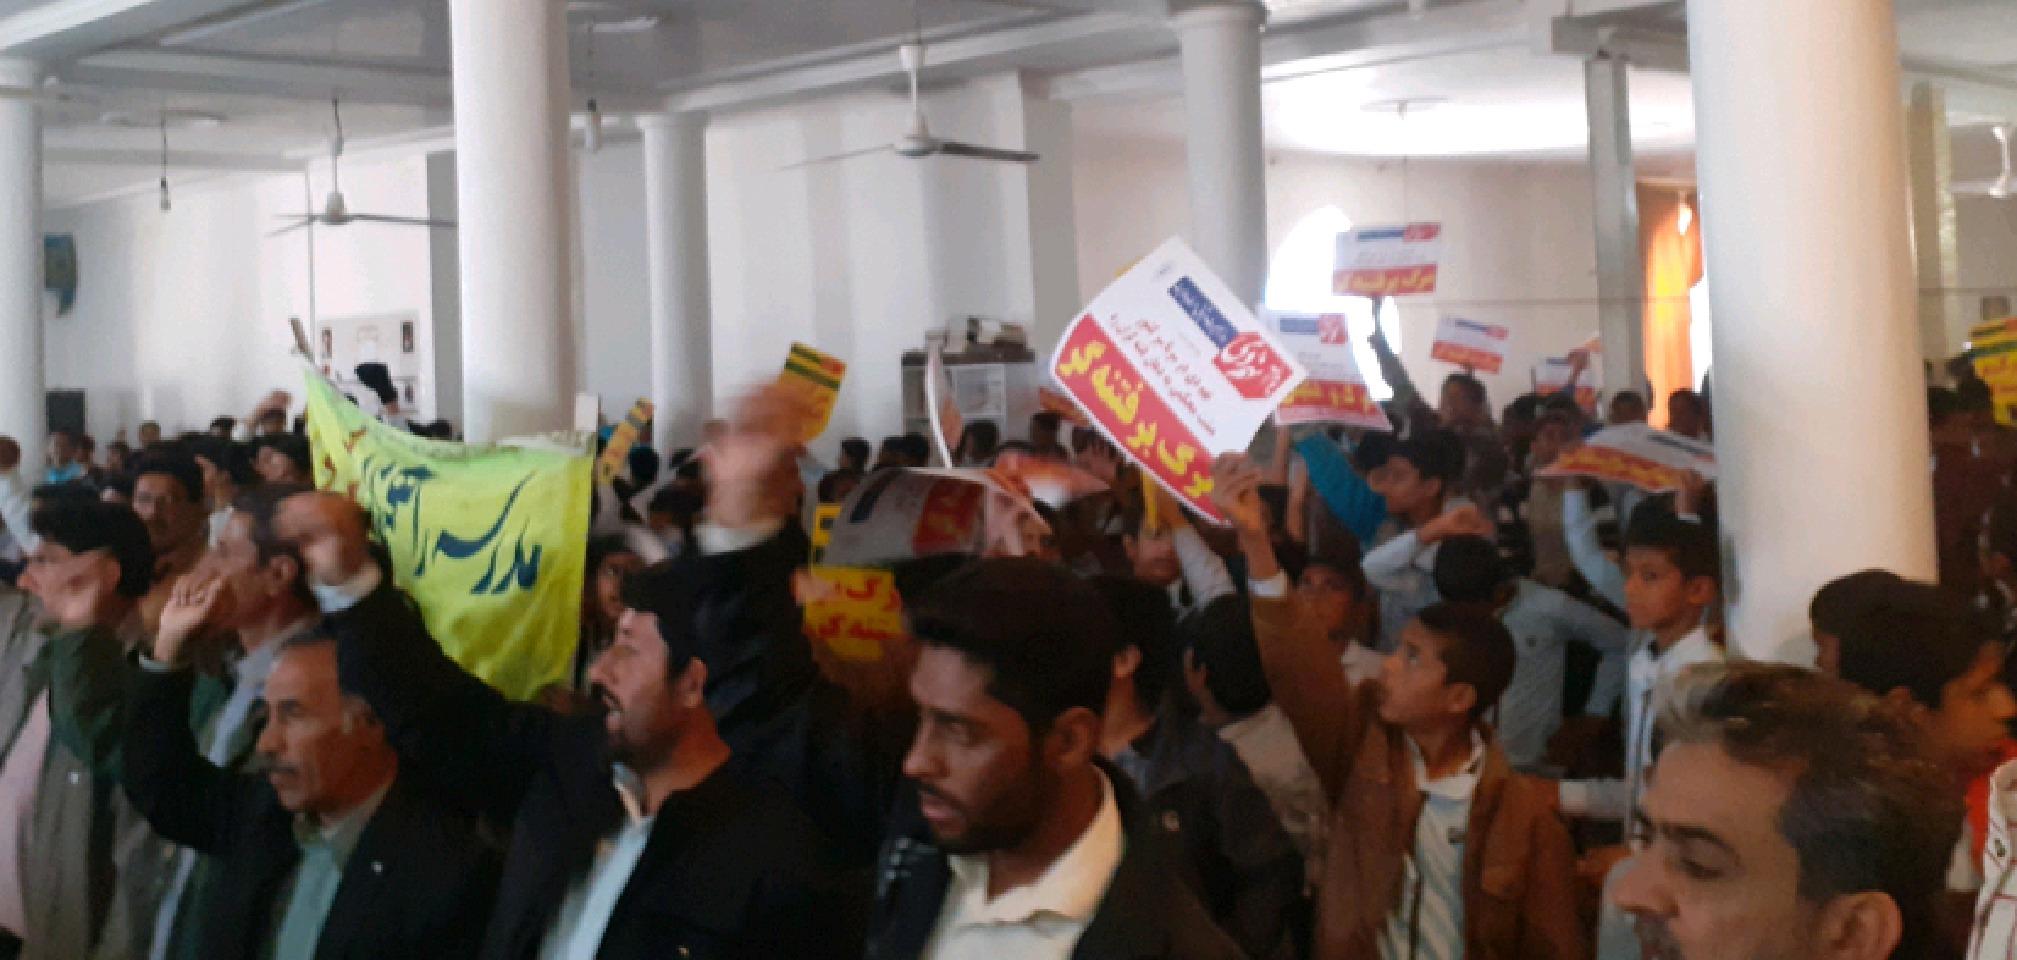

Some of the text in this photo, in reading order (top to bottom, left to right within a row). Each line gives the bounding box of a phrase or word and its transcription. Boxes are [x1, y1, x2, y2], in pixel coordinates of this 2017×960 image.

[1092, 364, 1143, 424] فتنه
[1126, 421, 1157, 458] بر
[432, 468, 543, 595] مدرسه
